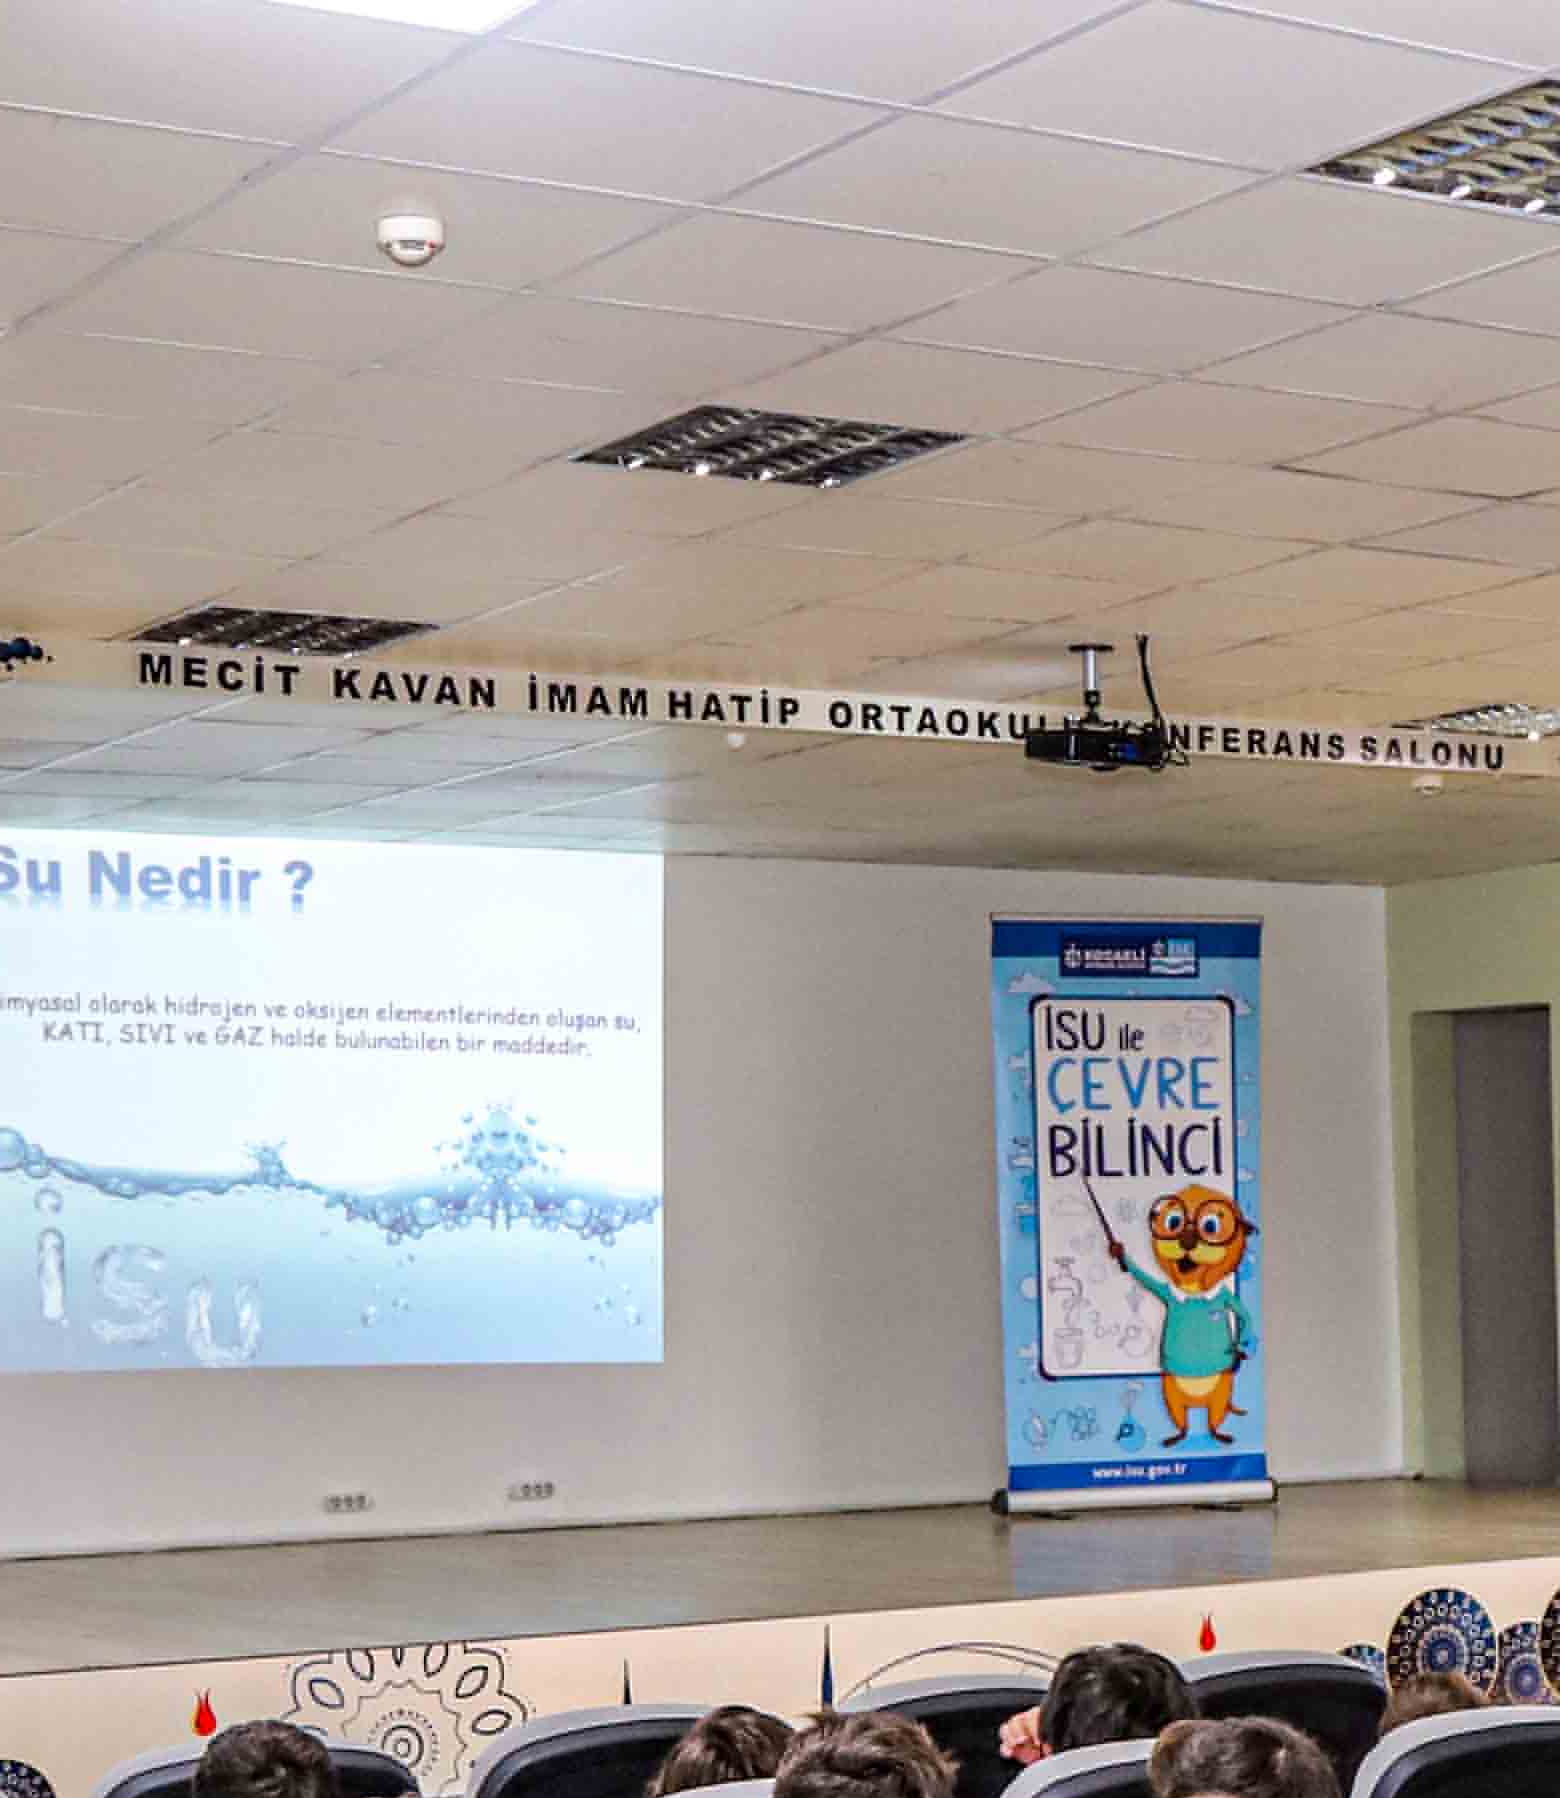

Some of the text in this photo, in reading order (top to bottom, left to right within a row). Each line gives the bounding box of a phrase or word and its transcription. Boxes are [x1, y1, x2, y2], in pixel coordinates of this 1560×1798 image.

[140, 653, 1505, 770] MECİT KAVAN İMAM HATİP ORTAOKU NFERANS SALONU
[88, 849, 262, 903] Nedir
[283, 859, 314, 905] ?
[87, 991, 158, 1016] olarak
[164, 992, 257, 1023] hidrojen
[263, 1003, 289, 1018] ve
[293, 999, 369, 1026] oksijen
[375, 1001, 540, 1027] elementlerinden
[1119, 1023, 1145, 1051] ile
[183, 1028, 208, 1046] ve
[214, 1024, 265, 1047] GAZ
[271, 1027, 328, 1049] halde
[335, 1029, 449, 1051] bulunabilen
[455, 1032, 485, 1051] bir
[1047, 1056, 1220, 1114] ÇEVRE
[1048, 1115, 1223, 1178] BİLİNCİ
